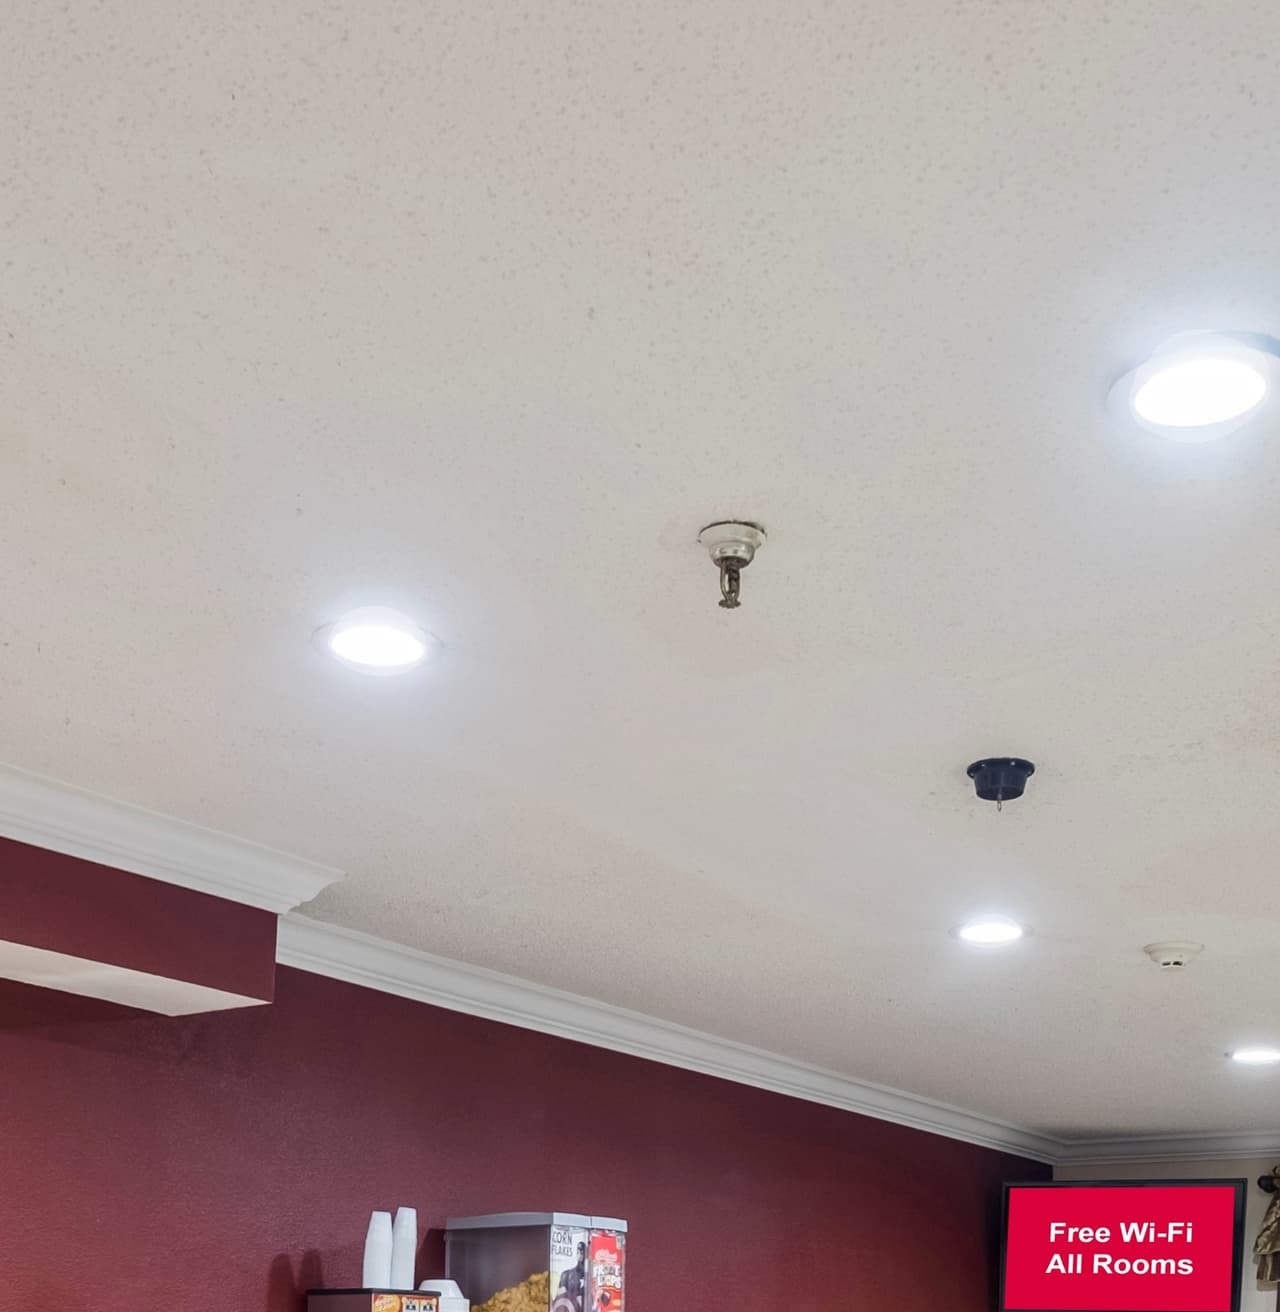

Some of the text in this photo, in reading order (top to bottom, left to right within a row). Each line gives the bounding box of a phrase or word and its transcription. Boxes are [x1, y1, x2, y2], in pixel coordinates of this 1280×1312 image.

[1049, 1222, 1193, 1243] Free Wi-Fi
[1045, 1253, 1194, 1275] All Rooms
